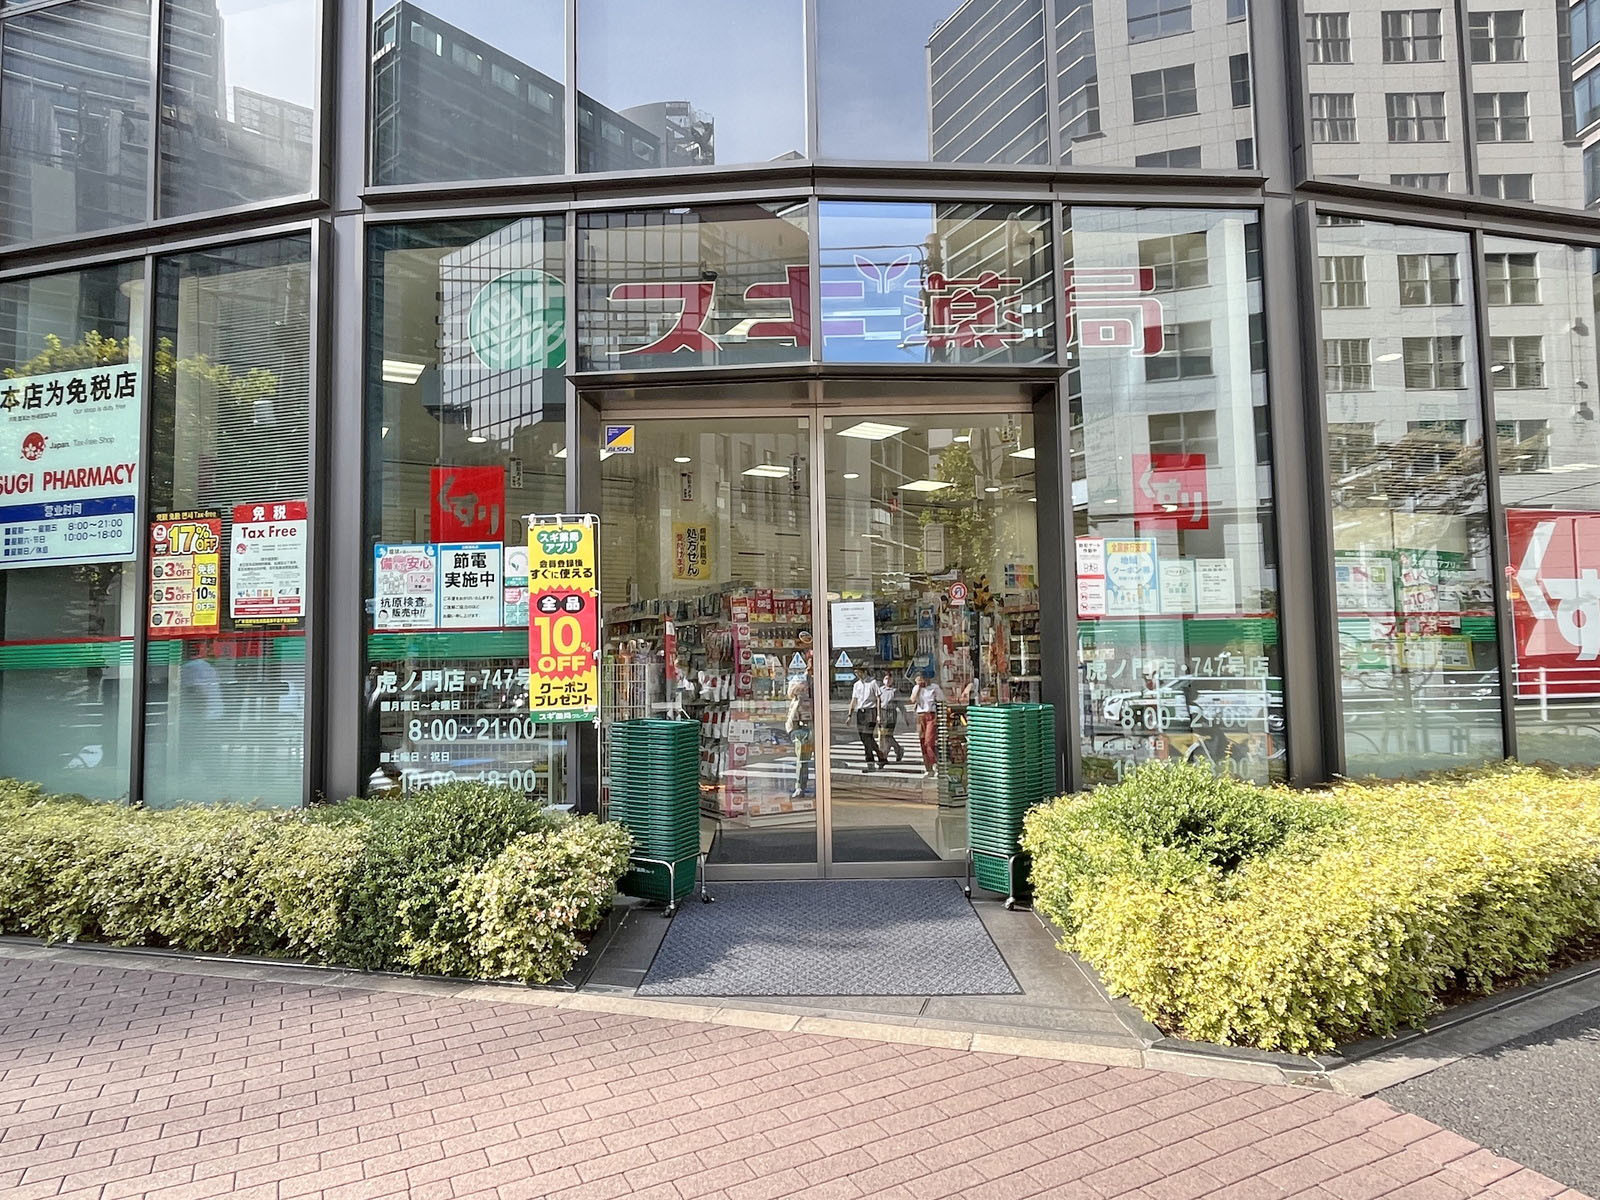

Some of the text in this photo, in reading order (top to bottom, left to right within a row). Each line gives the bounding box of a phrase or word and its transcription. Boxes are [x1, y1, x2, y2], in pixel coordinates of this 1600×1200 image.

[606, 254, 1164, 358] スギ薬局
[0, 371, 137, 412] 本店为免税店
[49, 441, 70, 450] Japan
[98, 436, 115, 445] Shop
[43, 463, 136, 491] PHARMACY
[1139, 463, 1203, 522] くすり
[44, 503, 82, 518] 营业时间
[438, 474, 499, 535] くすり
[241, 526, 297, 539] Tax Free
[196, 538, 216, 551] OFF
[545, 543, 574, 553] アプリ
[687, 528, 700, 577] 処方せん
[453, 552, 487, 569] 節電
[176, 569, 191, 577] OFF
[445, 571, 495, 588] 実施中
[530, 568, 593, 579] すぐに使える
[176, 593, 191, 601] OFF
[196, 586, 216, 599] 10%
[380, 597, 425, 608] 抗原検査
[541, 596, 580, 611] 全品
[175, 617, 190, 625] OFF
[534, 616, 591, 655] 10%
[538, 655, 586, 673] OFF
[540, 682, 587, 694] クーポン
[535, 694, 593, 706] プレゼント
